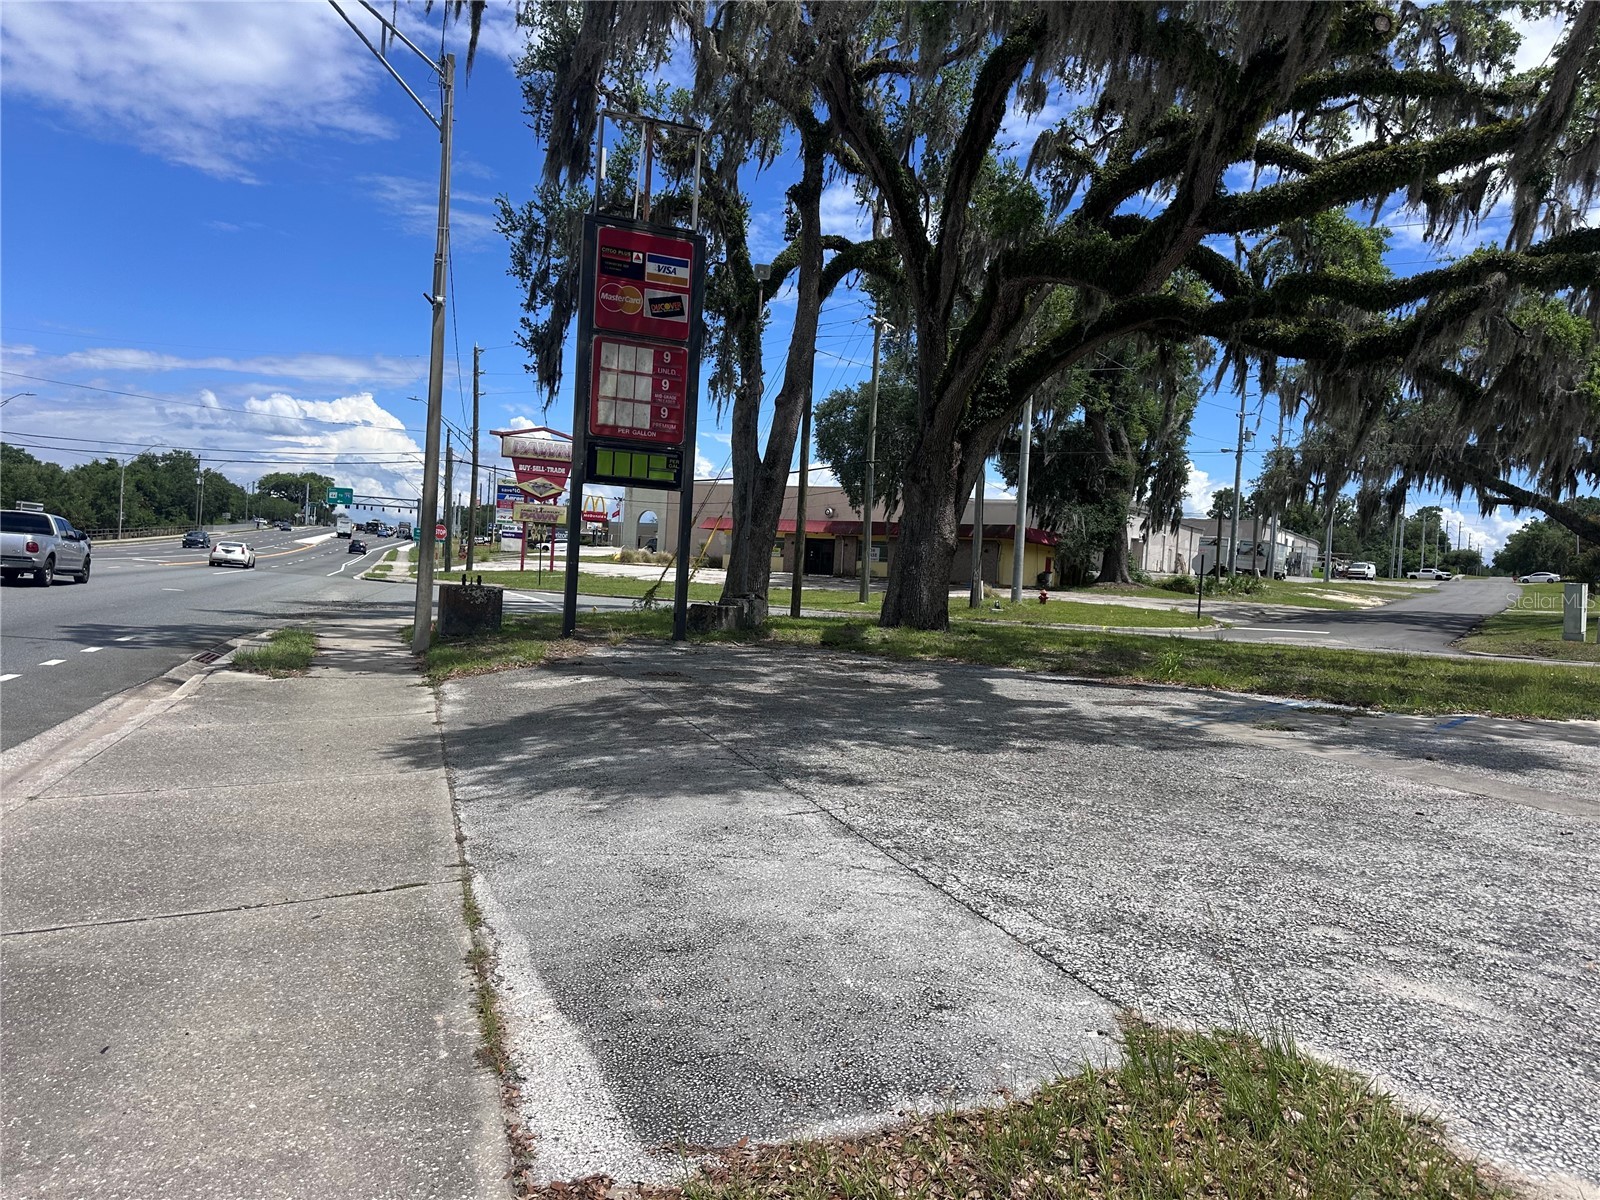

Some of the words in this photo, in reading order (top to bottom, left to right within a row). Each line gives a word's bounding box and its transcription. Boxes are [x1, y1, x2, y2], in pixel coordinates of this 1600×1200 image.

[657, 265, 677, 275] VISA
[601, 292, 641, 305] MasterCard
[663, 351, 671, 363] 9
[661, 379, 669, 391] 9
[660, 407, 668, 419] 9
[653, 422, 676, 430] PREMIUM
[632, 429, 657, 437] GALLON
[519, 511, 559, 522] PAWN
